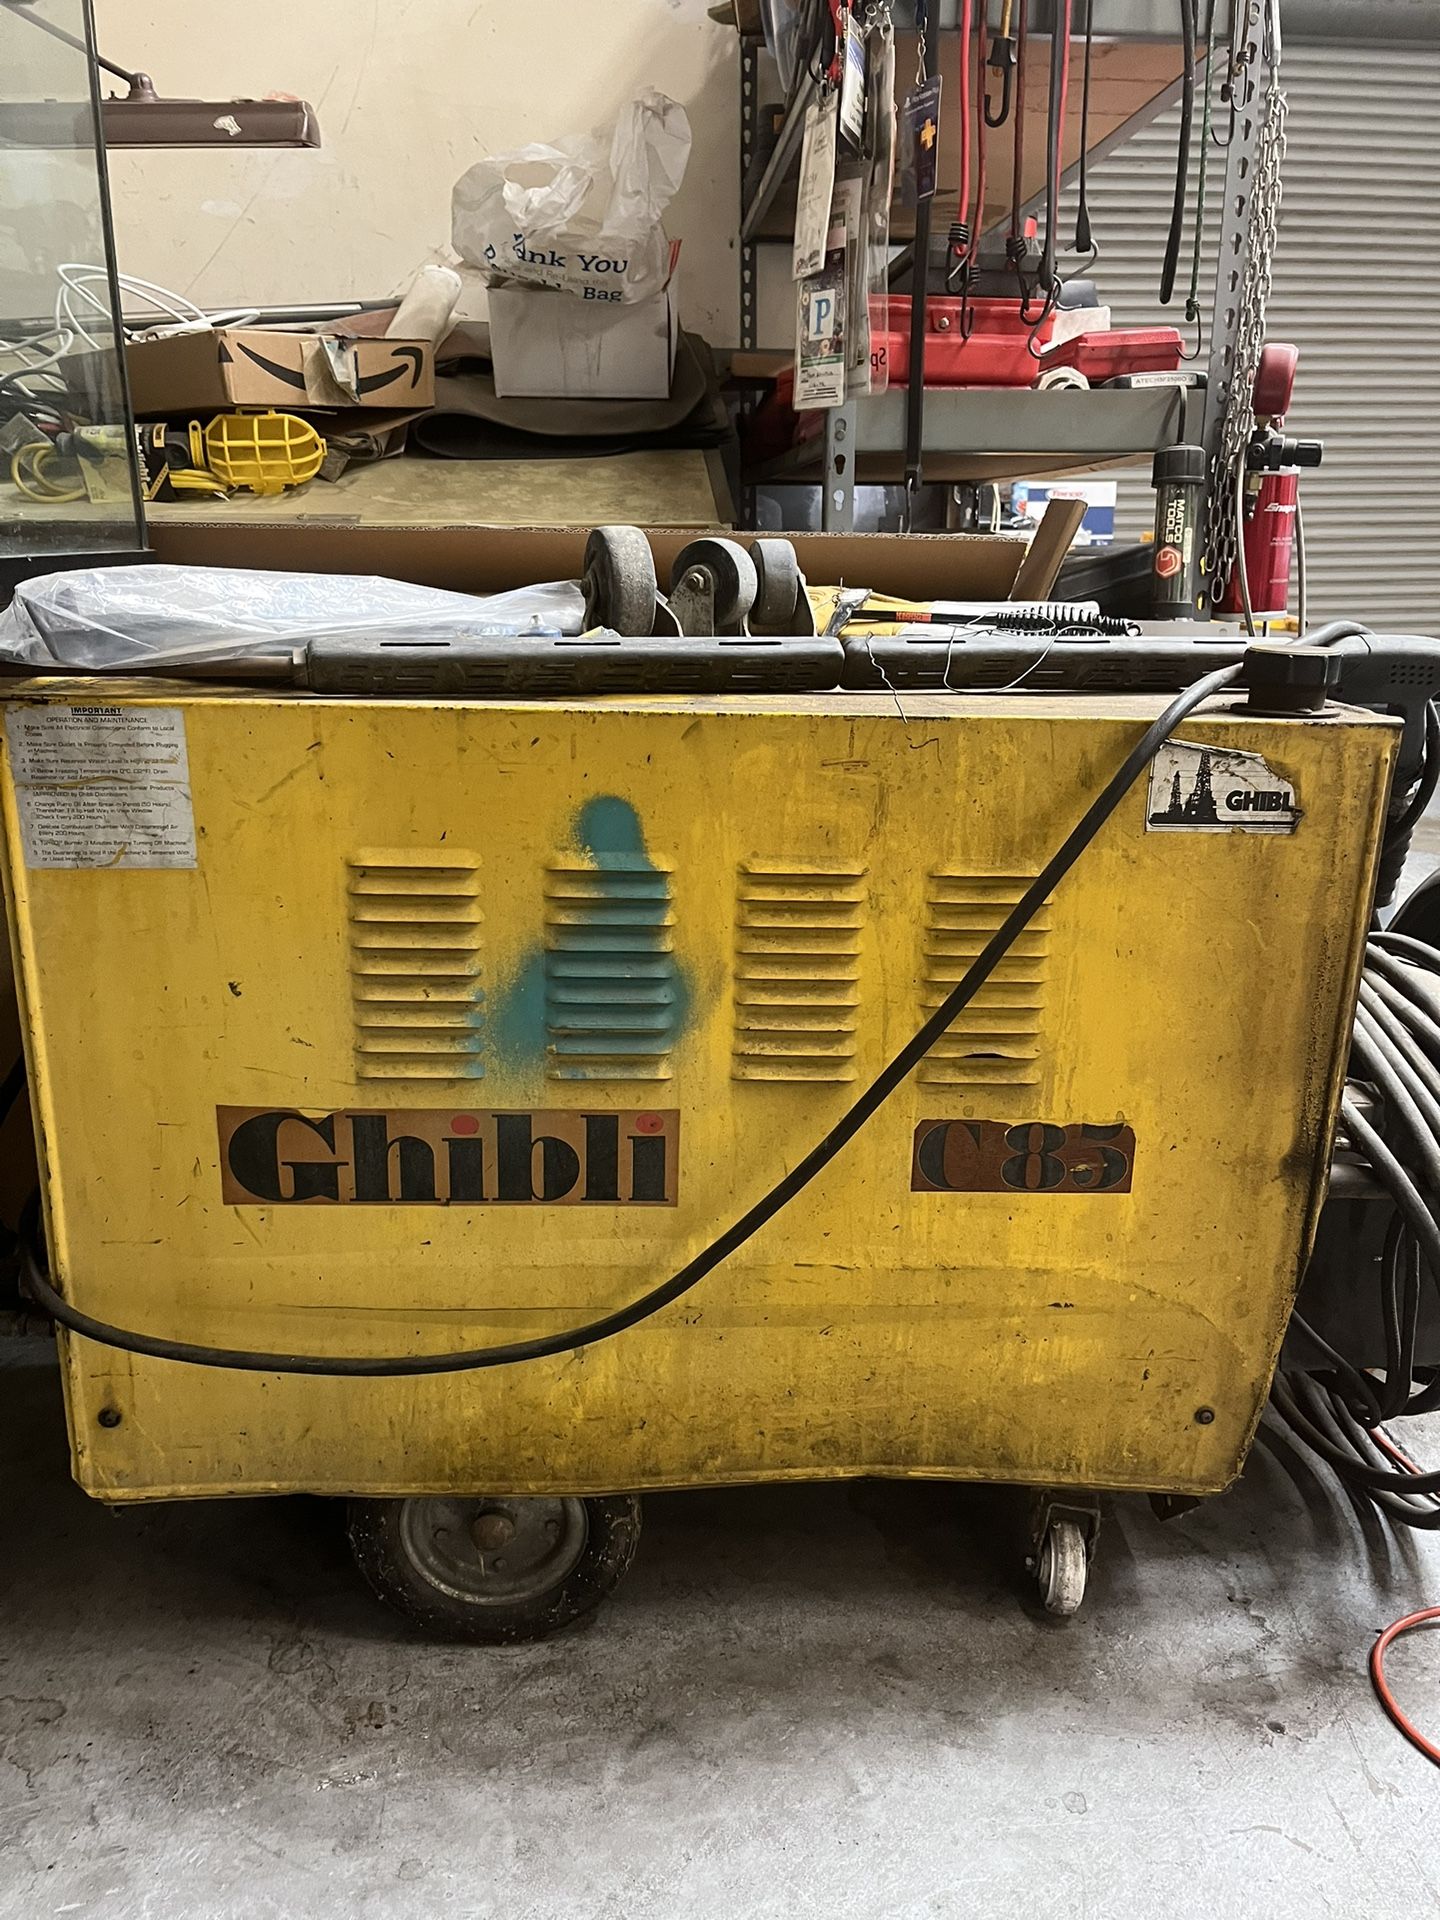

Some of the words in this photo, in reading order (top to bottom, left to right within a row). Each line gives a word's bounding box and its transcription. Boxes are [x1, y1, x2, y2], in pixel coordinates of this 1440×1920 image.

[577, 254, 629, 274] You
[583, 286, 623, 302] Bag
[1165, 499, 1177, 544] TOOLS
[1173, 499, 1186, 544] MATCO
[71, 707, 122, 715] IMPORTANT
[228, 1111, 669, 1202] Ghibli
[918, 1122, 1129, 1190] C85
